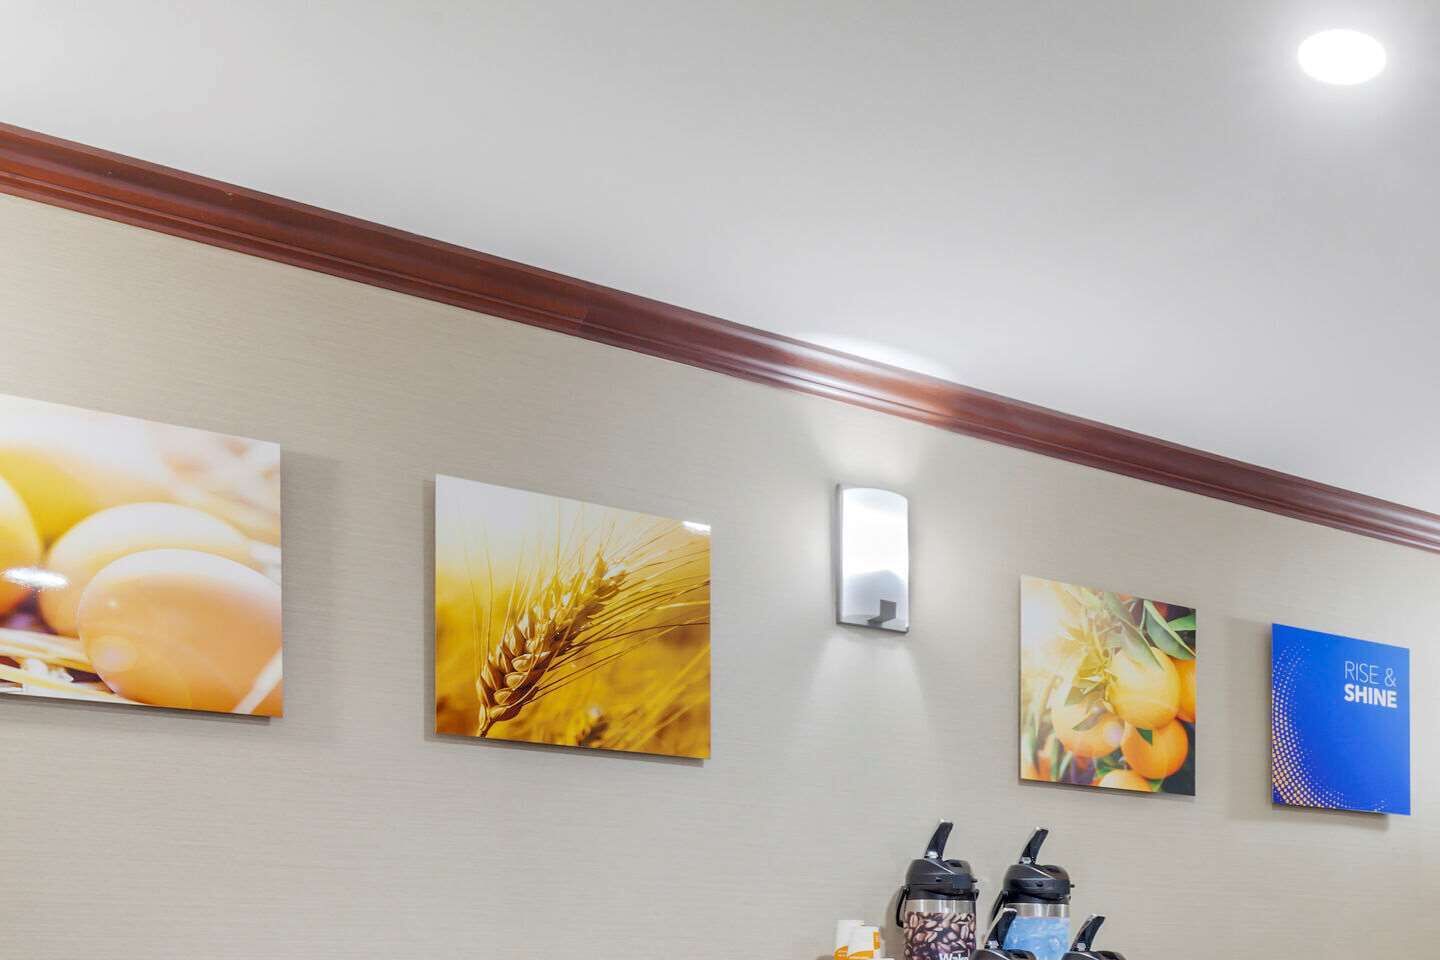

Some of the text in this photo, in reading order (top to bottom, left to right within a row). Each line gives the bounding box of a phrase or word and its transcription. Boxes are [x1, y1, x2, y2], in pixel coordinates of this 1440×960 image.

[1344, 661, 1397, 688] RISE &
[1344, 684, 1397, 708] SHINE
